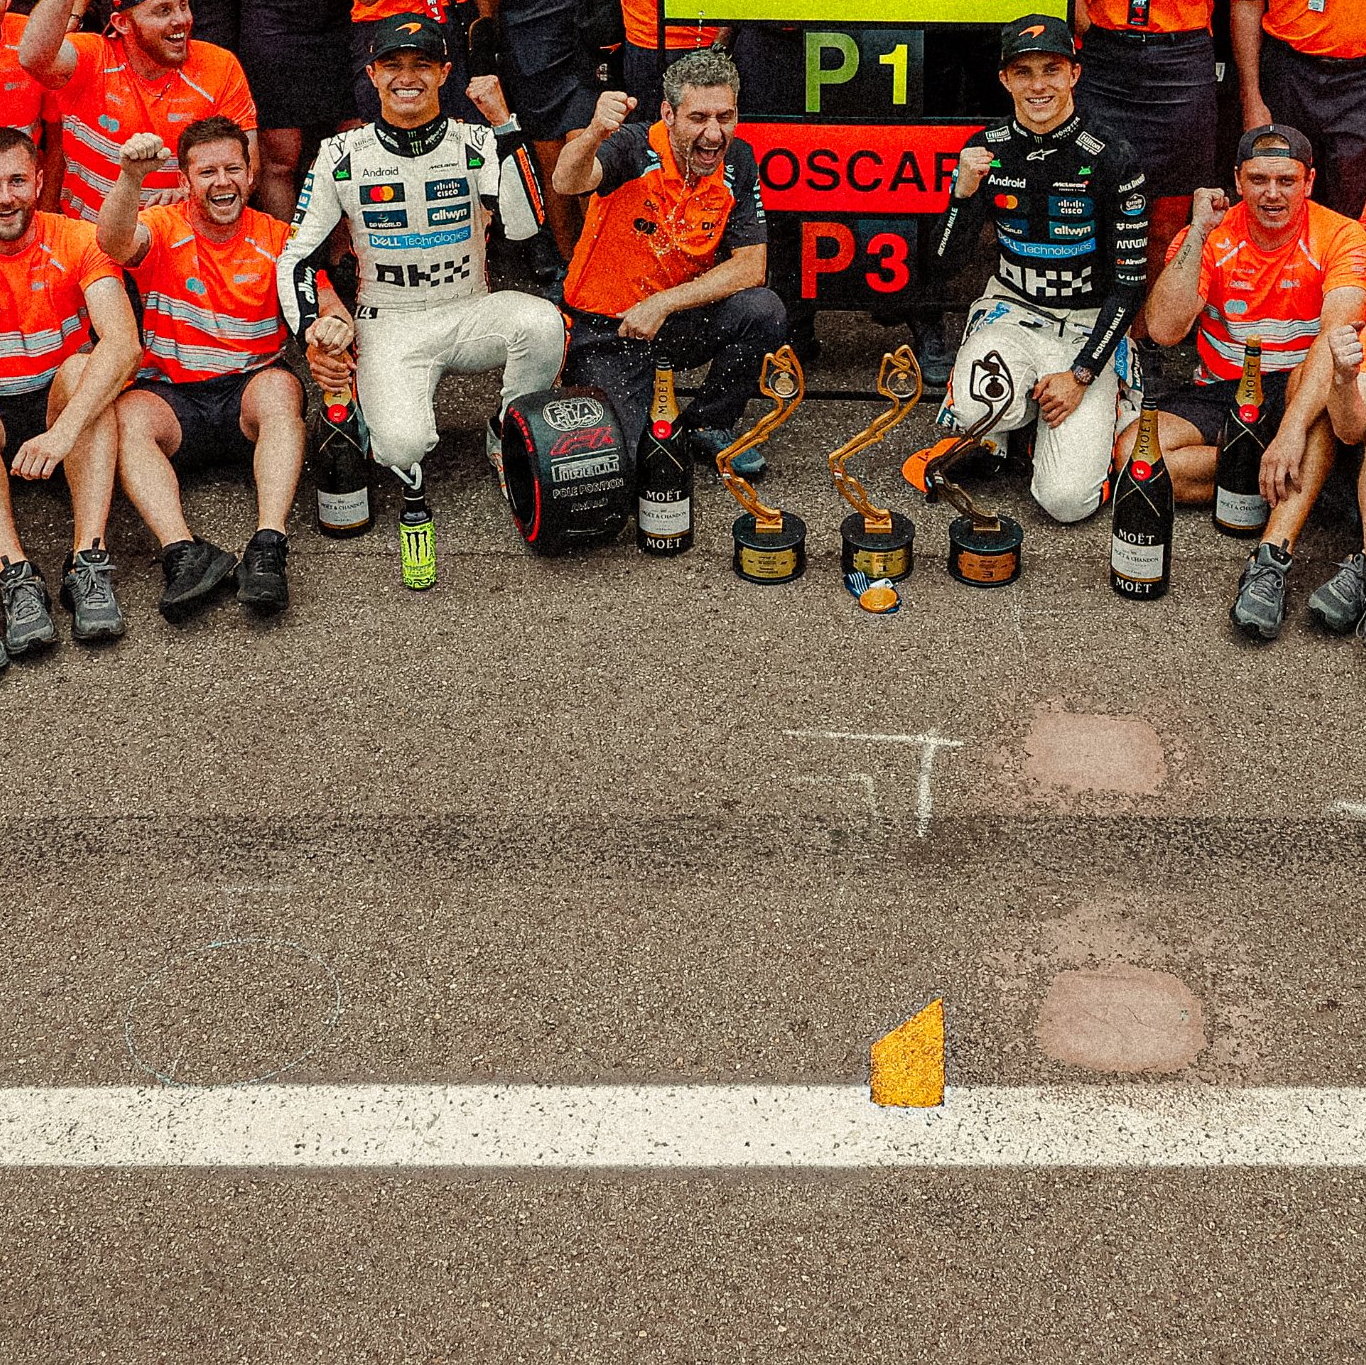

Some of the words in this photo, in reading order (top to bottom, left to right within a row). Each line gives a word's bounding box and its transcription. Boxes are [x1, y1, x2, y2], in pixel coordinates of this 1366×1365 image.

[362, 167, 399, 178] Android
[988, 174, 1026, 188] Android
[437, 188, 459, 197] CISCO
[432, 208, 467, 222] allwyn
[1054, 226, 1091, 236] allwyn
[371, 235, 401, 247] DELL
[402, 229, 469, 248] Technologies
[1021, 240, 1092, 256] Technologies
[360, 306, 373, 319] 4
[552, 454, 620, 482] PIRELLI
[553, 486, 577, 499] POLE
[579, 478, 624, 495] POSITION
[646, 490, 681, 501] MOËT
[647, 537, 681, 549] MOËT
[1119, 529, 1154, 545] MOËT
[1116, 577, 1152, 594] MOËT
